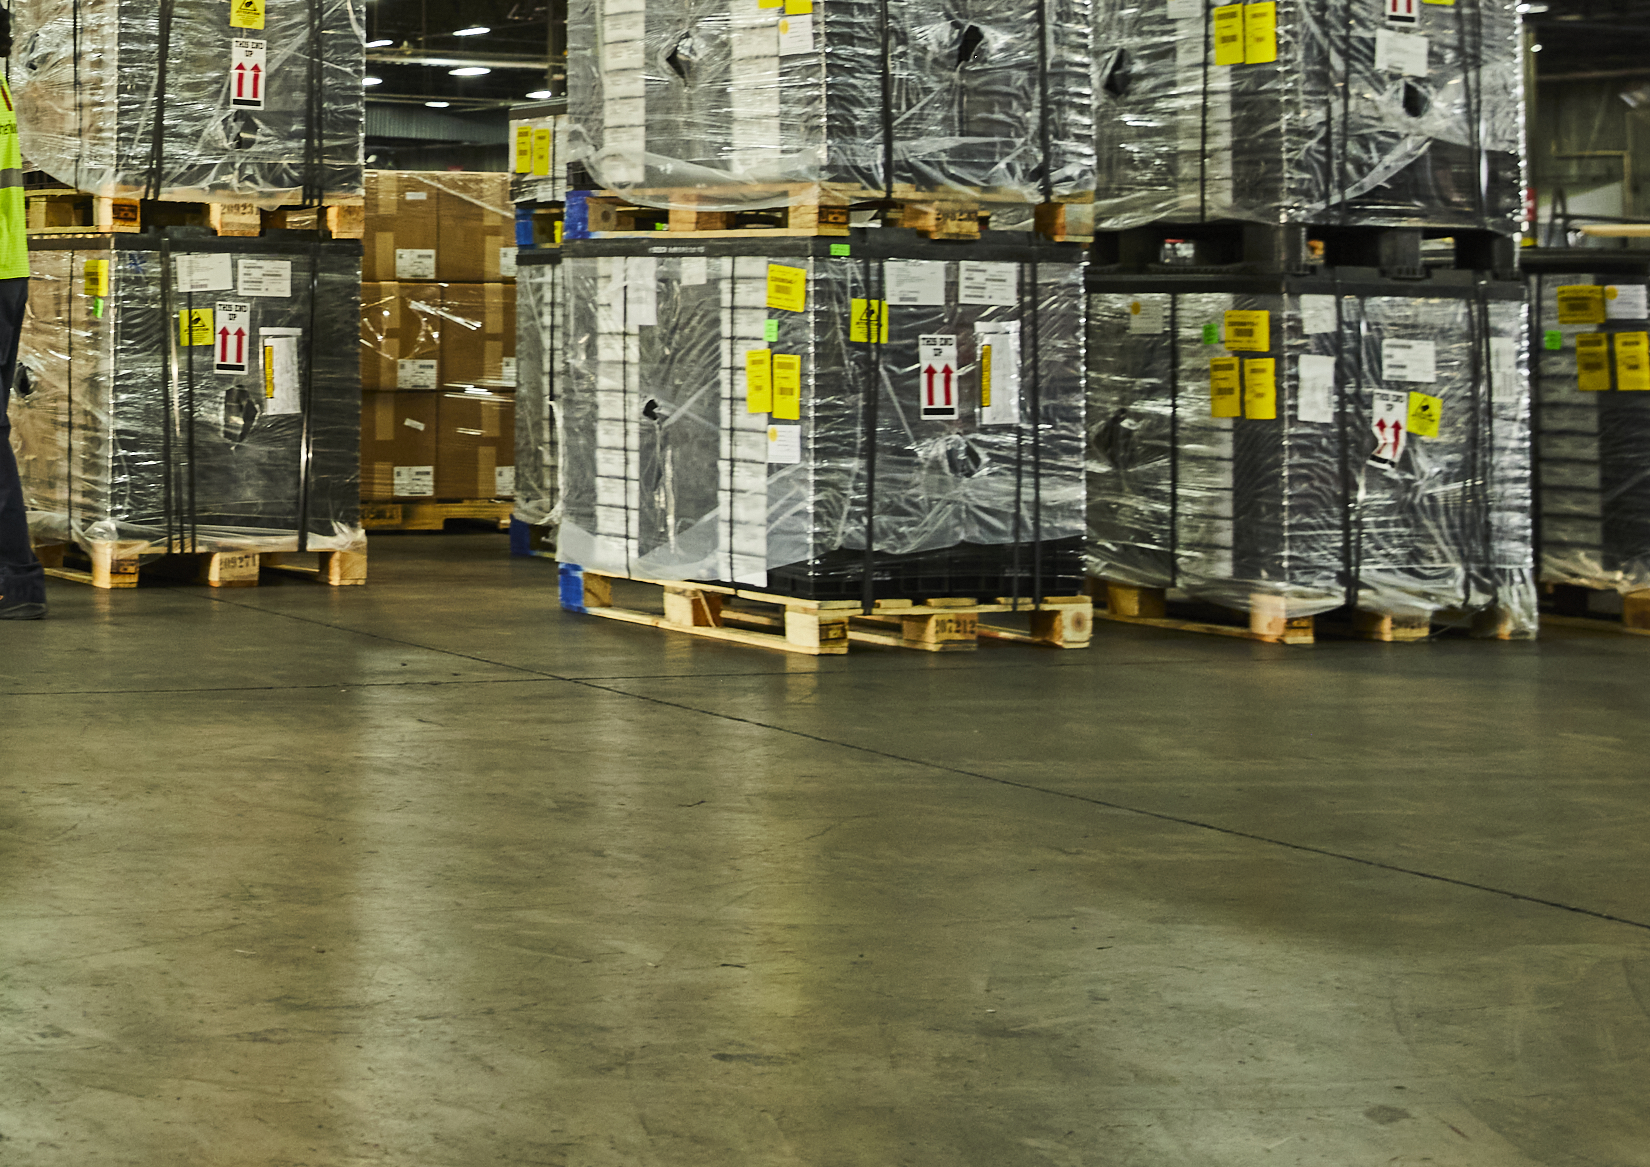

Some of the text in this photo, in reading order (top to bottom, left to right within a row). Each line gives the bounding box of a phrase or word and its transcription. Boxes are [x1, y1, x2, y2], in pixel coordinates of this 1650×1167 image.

[234, 40, 264, 50] THIS END
[218, 304, 248, 313] THIS END
[228, 313, 238, 322] UP
[922, 337, 954, 346] THIS END
[933, 348, 943, 357] UP
